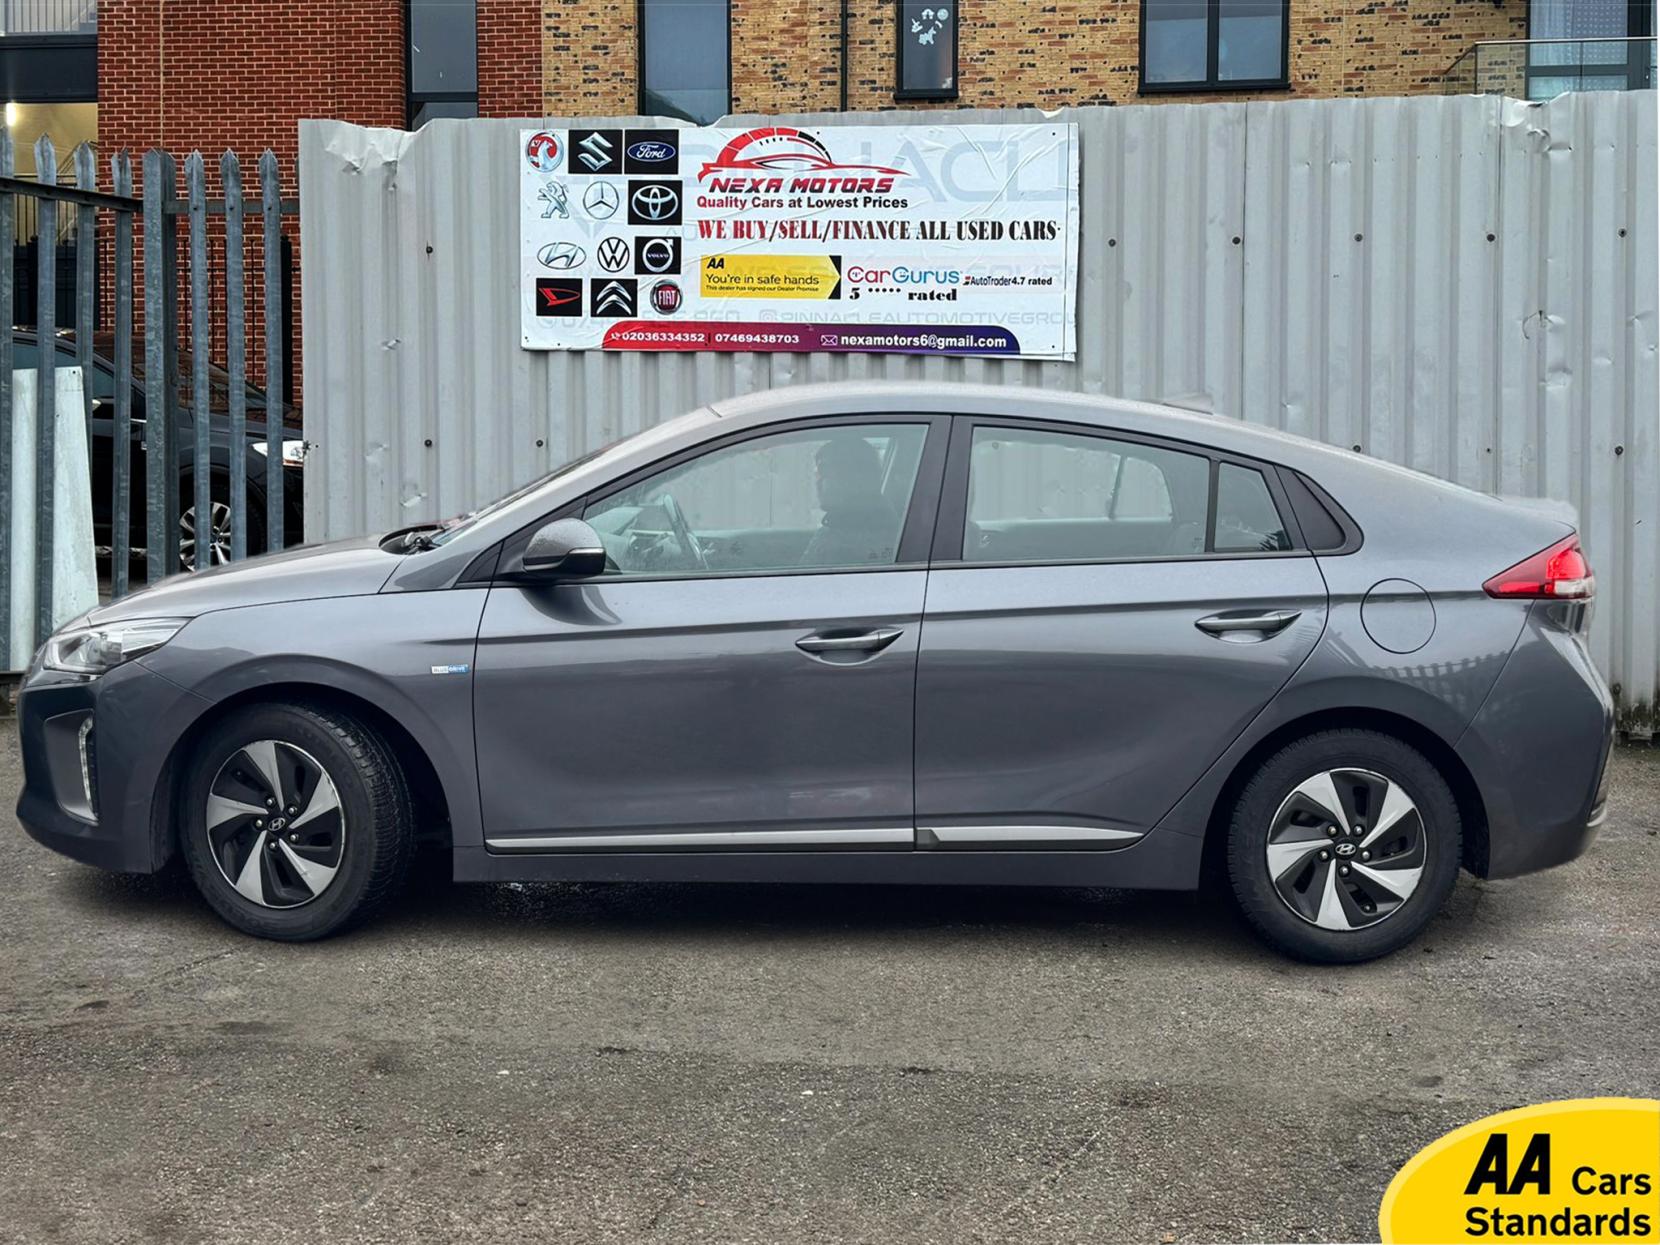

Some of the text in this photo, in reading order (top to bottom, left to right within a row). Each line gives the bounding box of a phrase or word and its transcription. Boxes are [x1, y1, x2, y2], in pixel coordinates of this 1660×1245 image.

[636, 144, 666, 159] Ford
[709, 178, 894, 193] NEXA MOTORS
[698, 196, 908, 211] Quality Cars at Lowest Prices
[698, 220, 726, 239] WE
[733, 220, 911, 242] BUY/SELL/FINANCE
[916, 220, 951, 240] ALL
[956, 220, 1004, 240] USED
[1009, 220, 1057, 240] CARS
[706, 257, 725, 269] AA
[706, 274, 819, 285] You're in safe hands
[847, 266, 960, 284] CarGurus
[1028, 277, 1053, 286] rated
[658, 290, 677, 306] FIAT
[849, 287, 957, 301] 5 rated
[622, 332, 705, 342] 02036334352
[715, 334, 799, 344] 07469438703
[840, 335, 1007, 350] nexamotors6@gmail.com
